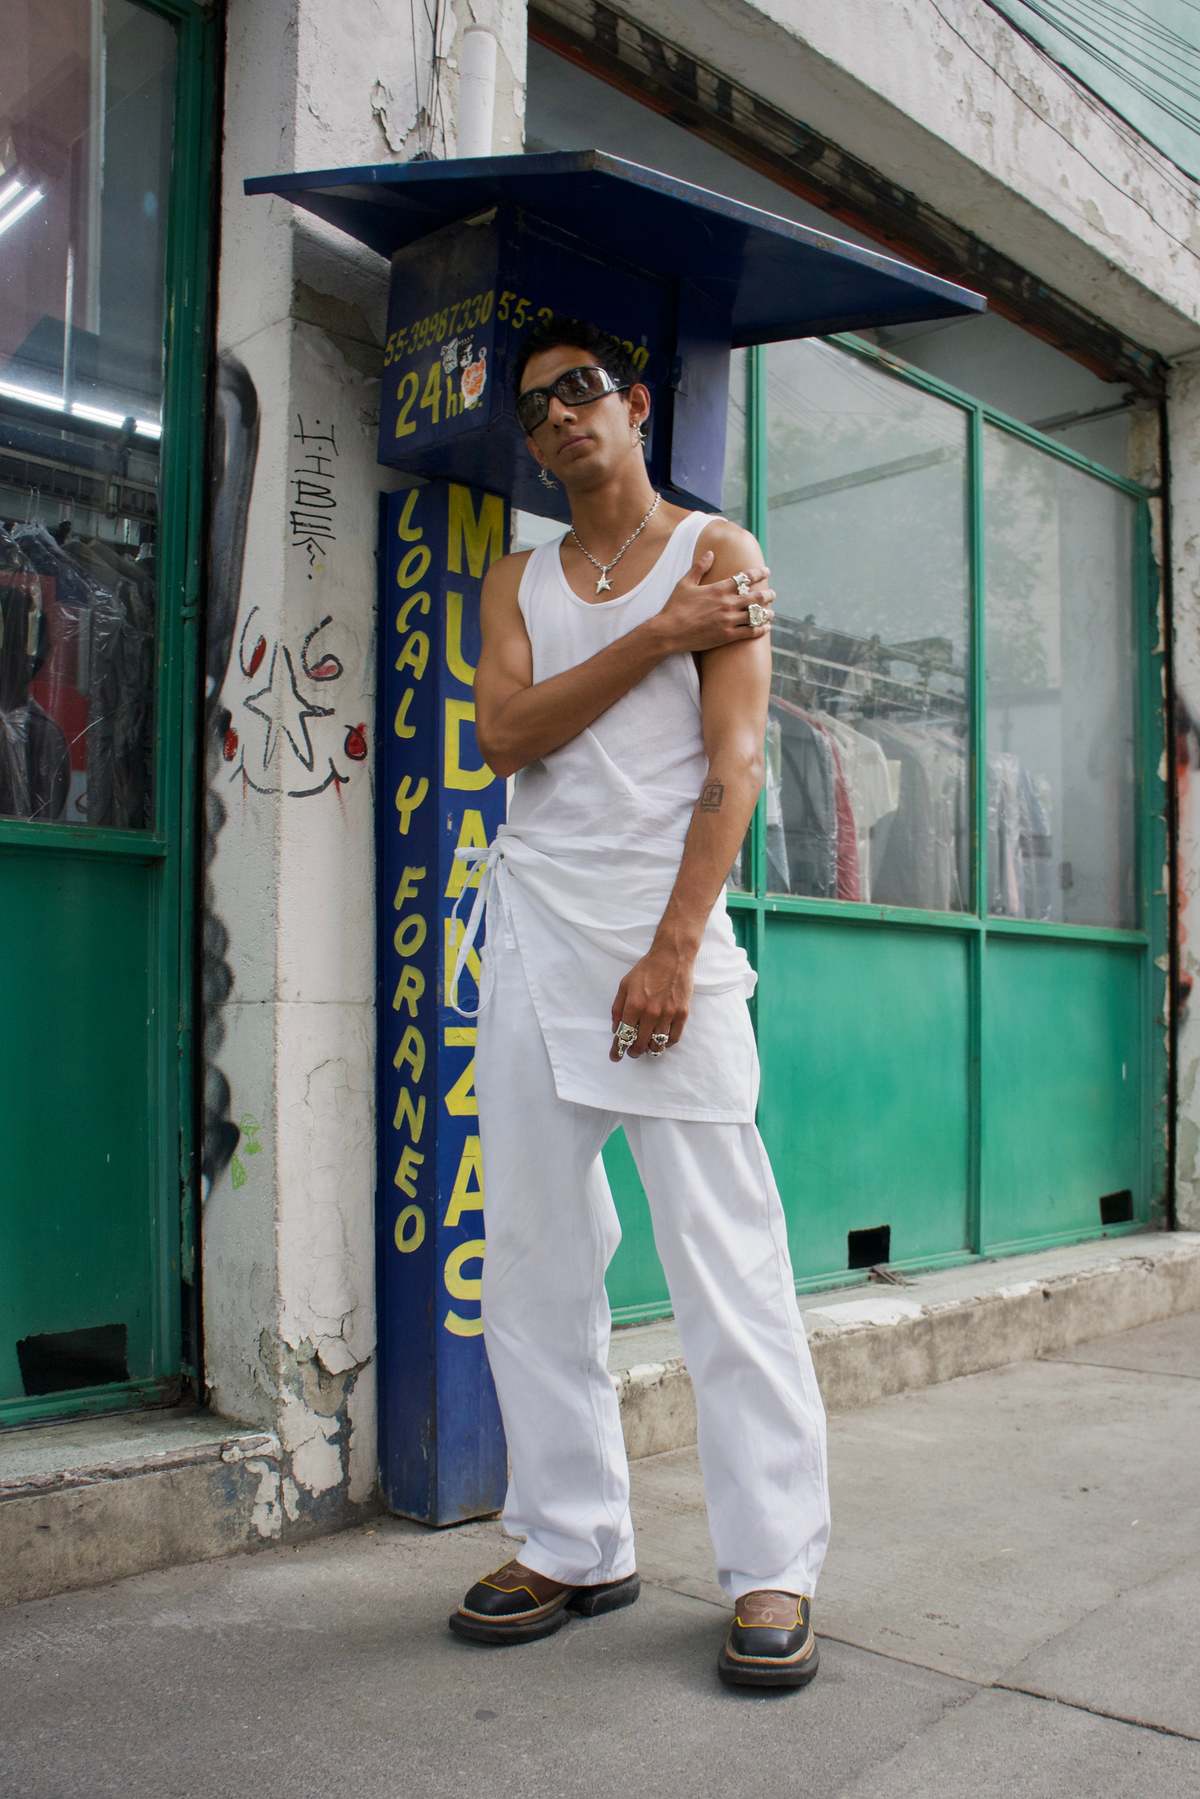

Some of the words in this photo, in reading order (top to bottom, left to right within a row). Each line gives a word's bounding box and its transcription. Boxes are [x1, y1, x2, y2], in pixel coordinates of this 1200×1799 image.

[394, 488, 432, 739] LOCAL
[395, 775, 430, 836] Y
[392, 866, 427, 1254] FORANEO
